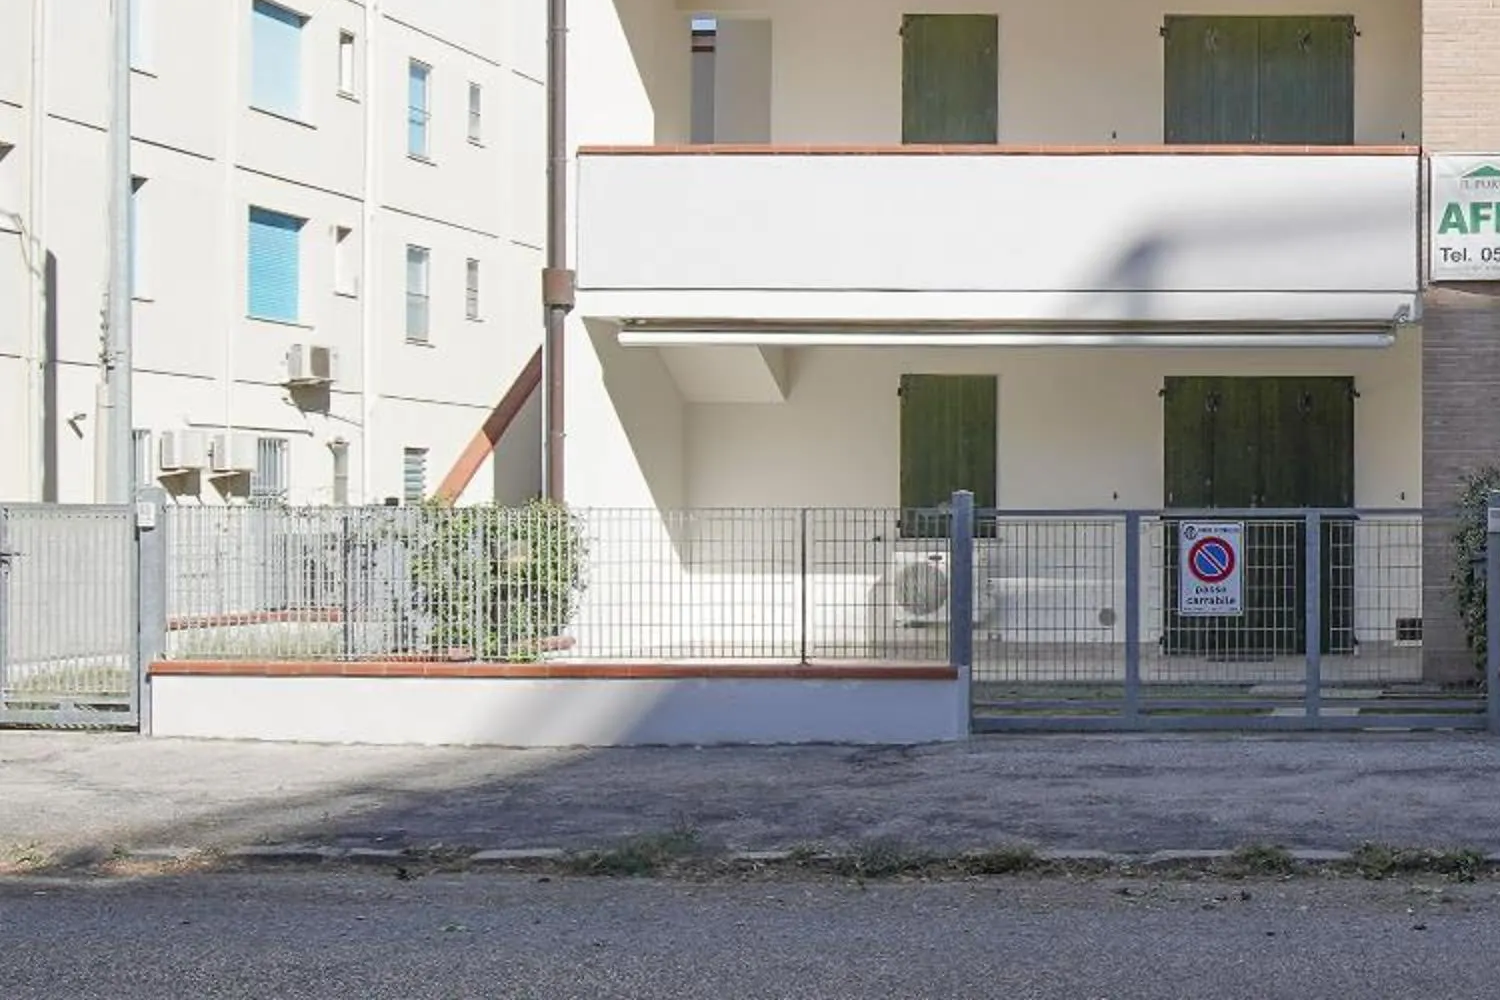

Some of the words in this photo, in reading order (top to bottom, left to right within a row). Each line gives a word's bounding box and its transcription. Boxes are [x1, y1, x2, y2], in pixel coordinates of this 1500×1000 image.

[1440, 247, 1473, 262] Tel.
[1195, 585, 1227, 594] passo
[1187, 595, 1236, 605] carrabile
